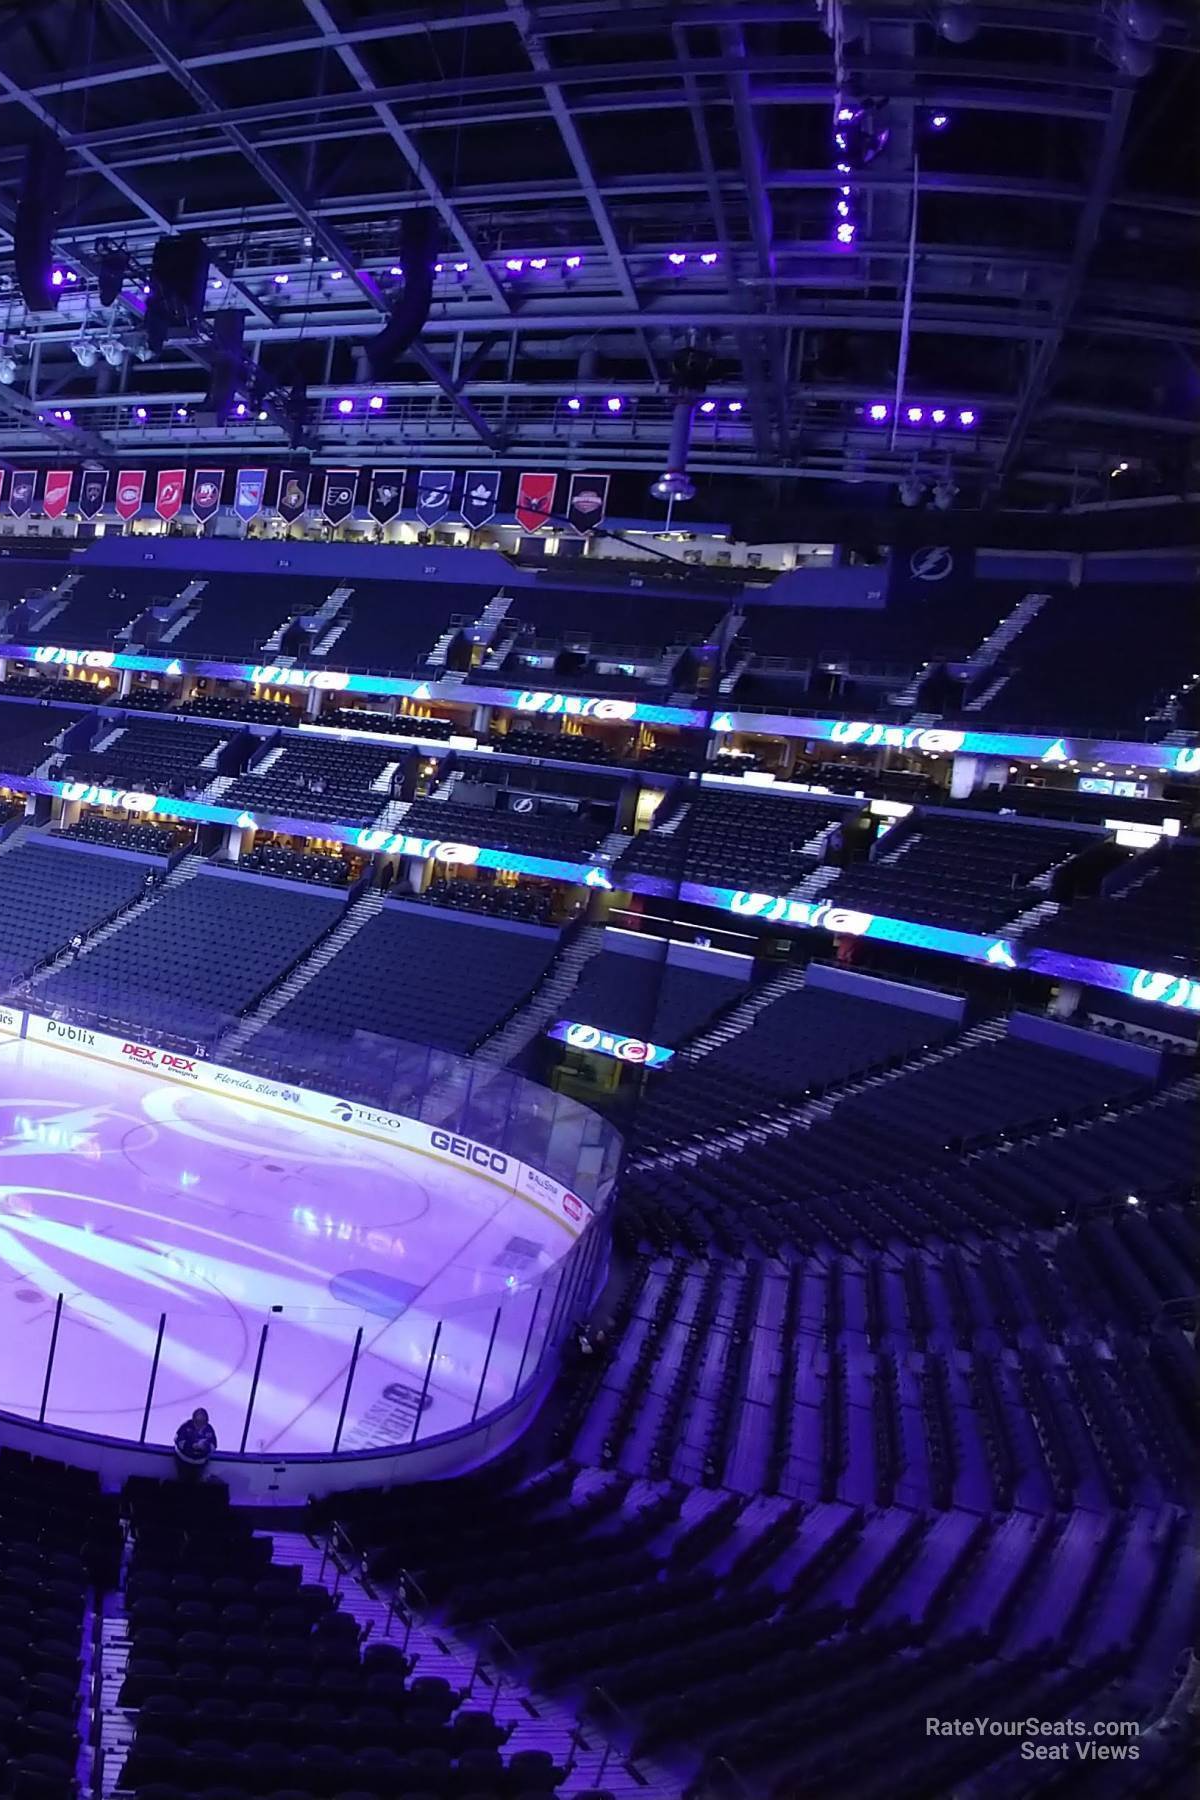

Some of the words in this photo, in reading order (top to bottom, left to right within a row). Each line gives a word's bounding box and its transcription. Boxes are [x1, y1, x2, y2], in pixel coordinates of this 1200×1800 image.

[46, 1021, 96, 1046] Publix
[121, 1043, 158, 1062] DEX
[160, 1053, 198, 1072] DEX
[214, 1072, 253, 1090] Florida
[255, 1085, 279, 1098] Blue
[355, 1108, 402, 1130] TECO
[430, 1130, 509, 1176] GEICO
